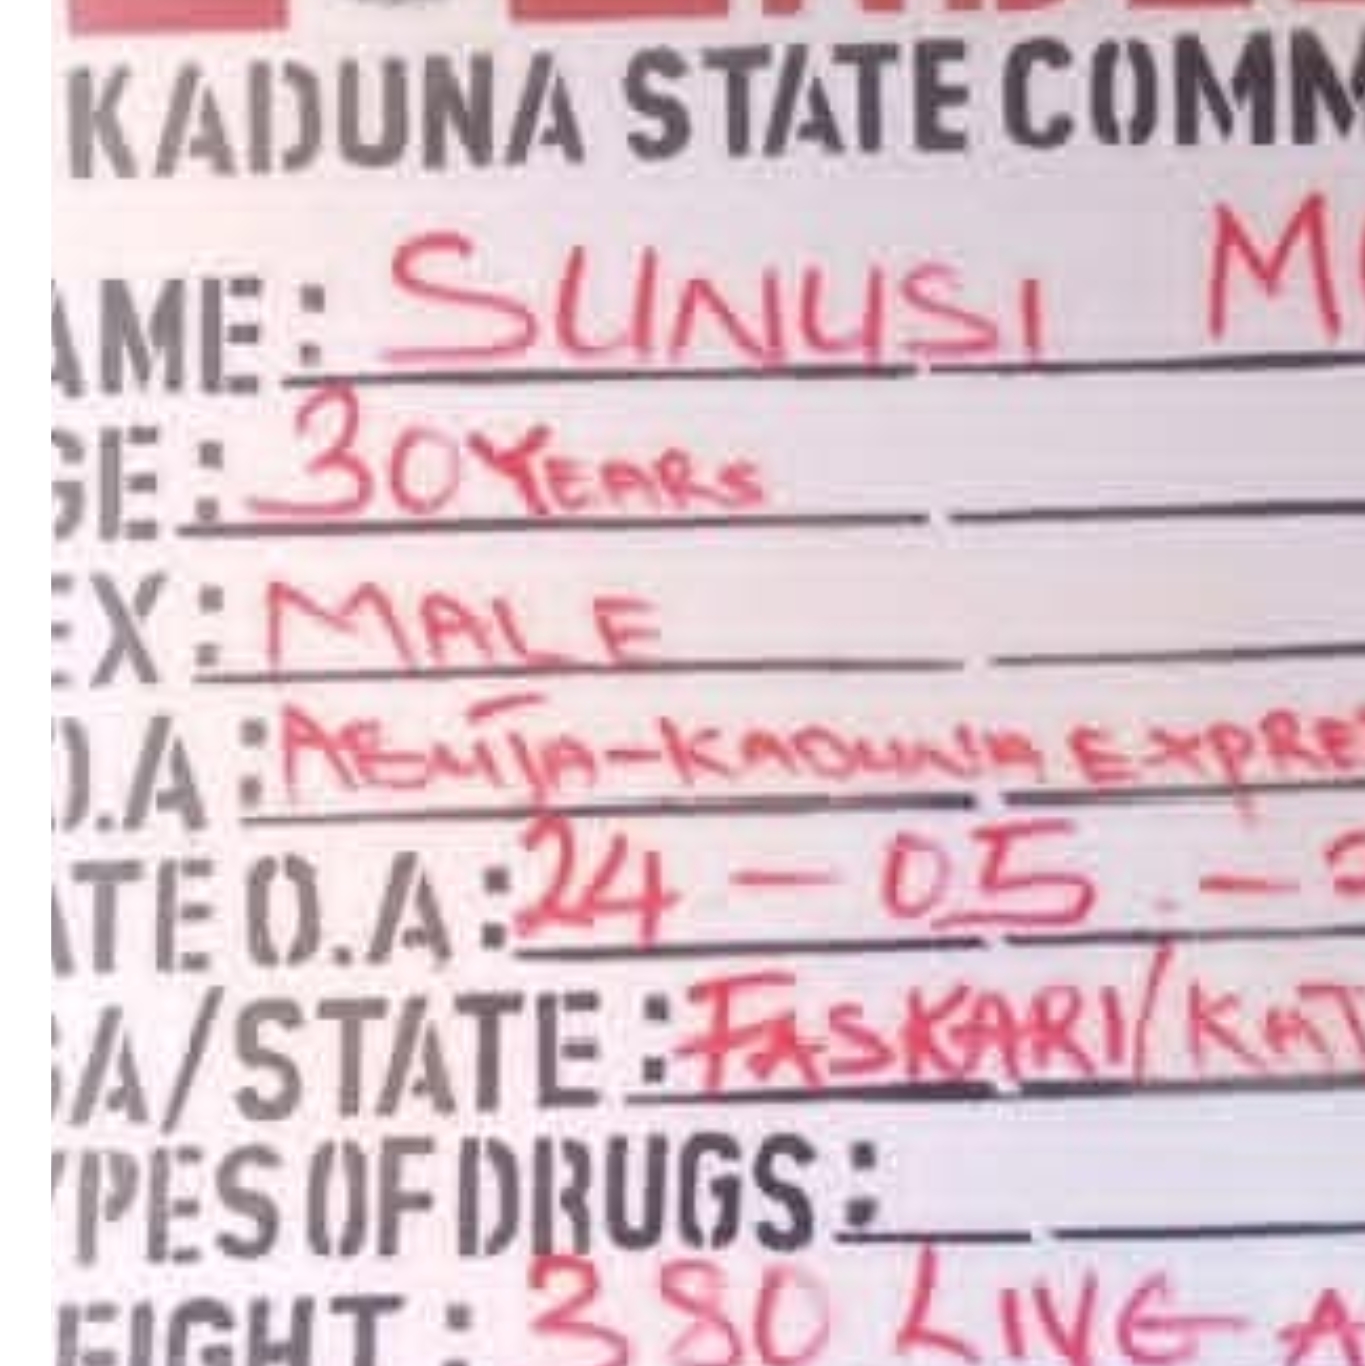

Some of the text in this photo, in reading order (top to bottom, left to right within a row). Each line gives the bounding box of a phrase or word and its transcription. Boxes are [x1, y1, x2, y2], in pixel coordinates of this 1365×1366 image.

[67, 51, 585, 180] KADUNA
[624, 40, 970, 161] STATE
[382, 232, 1044, 370] SUNUSI
[265, 579, 663, 685] MALE
[51, 857, 212, 977] TE
[512, 812, 682, 949] 24
[51, 985, 670, 1133] A/STATE:
[51, 1142, 283, 1268] PES
[306, 1136, 435, 1259] OF
